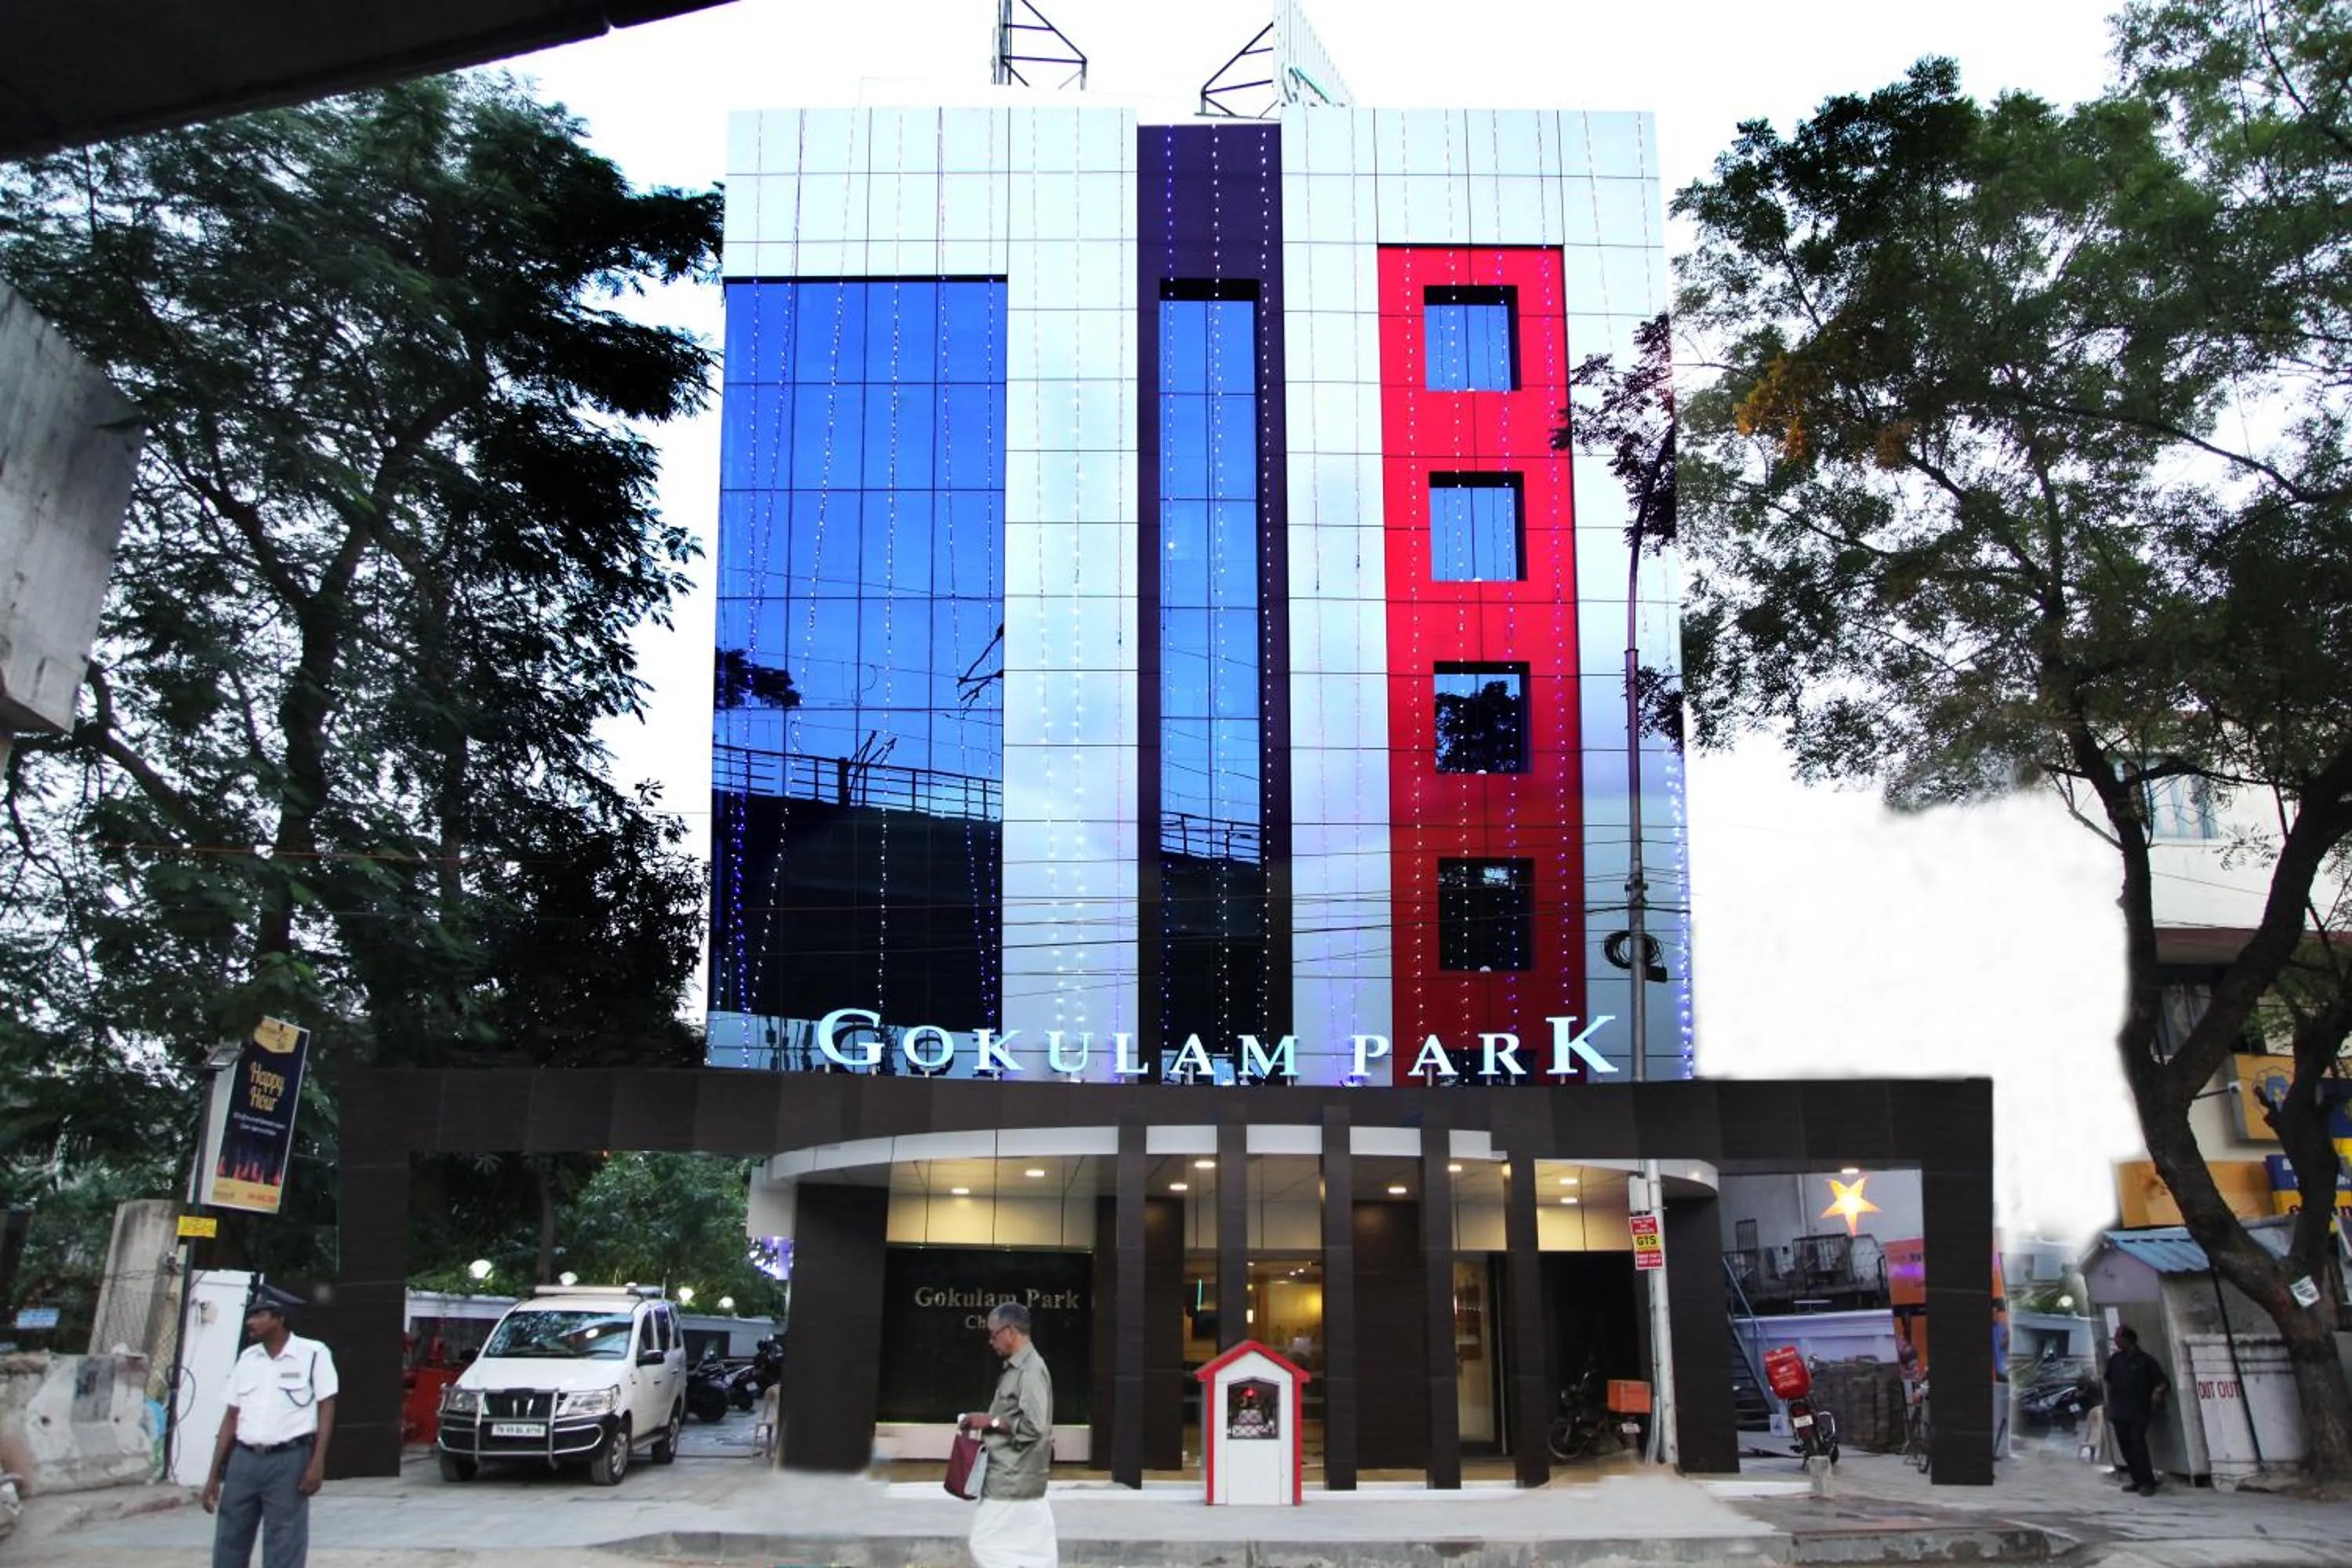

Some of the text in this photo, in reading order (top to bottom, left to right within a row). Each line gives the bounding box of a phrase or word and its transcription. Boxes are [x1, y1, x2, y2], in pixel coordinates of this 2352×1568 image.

[817, 1007, 1619, 1076] GOKULAM PARK
[914, 1287, 1080, 1309] Gokulam Park
